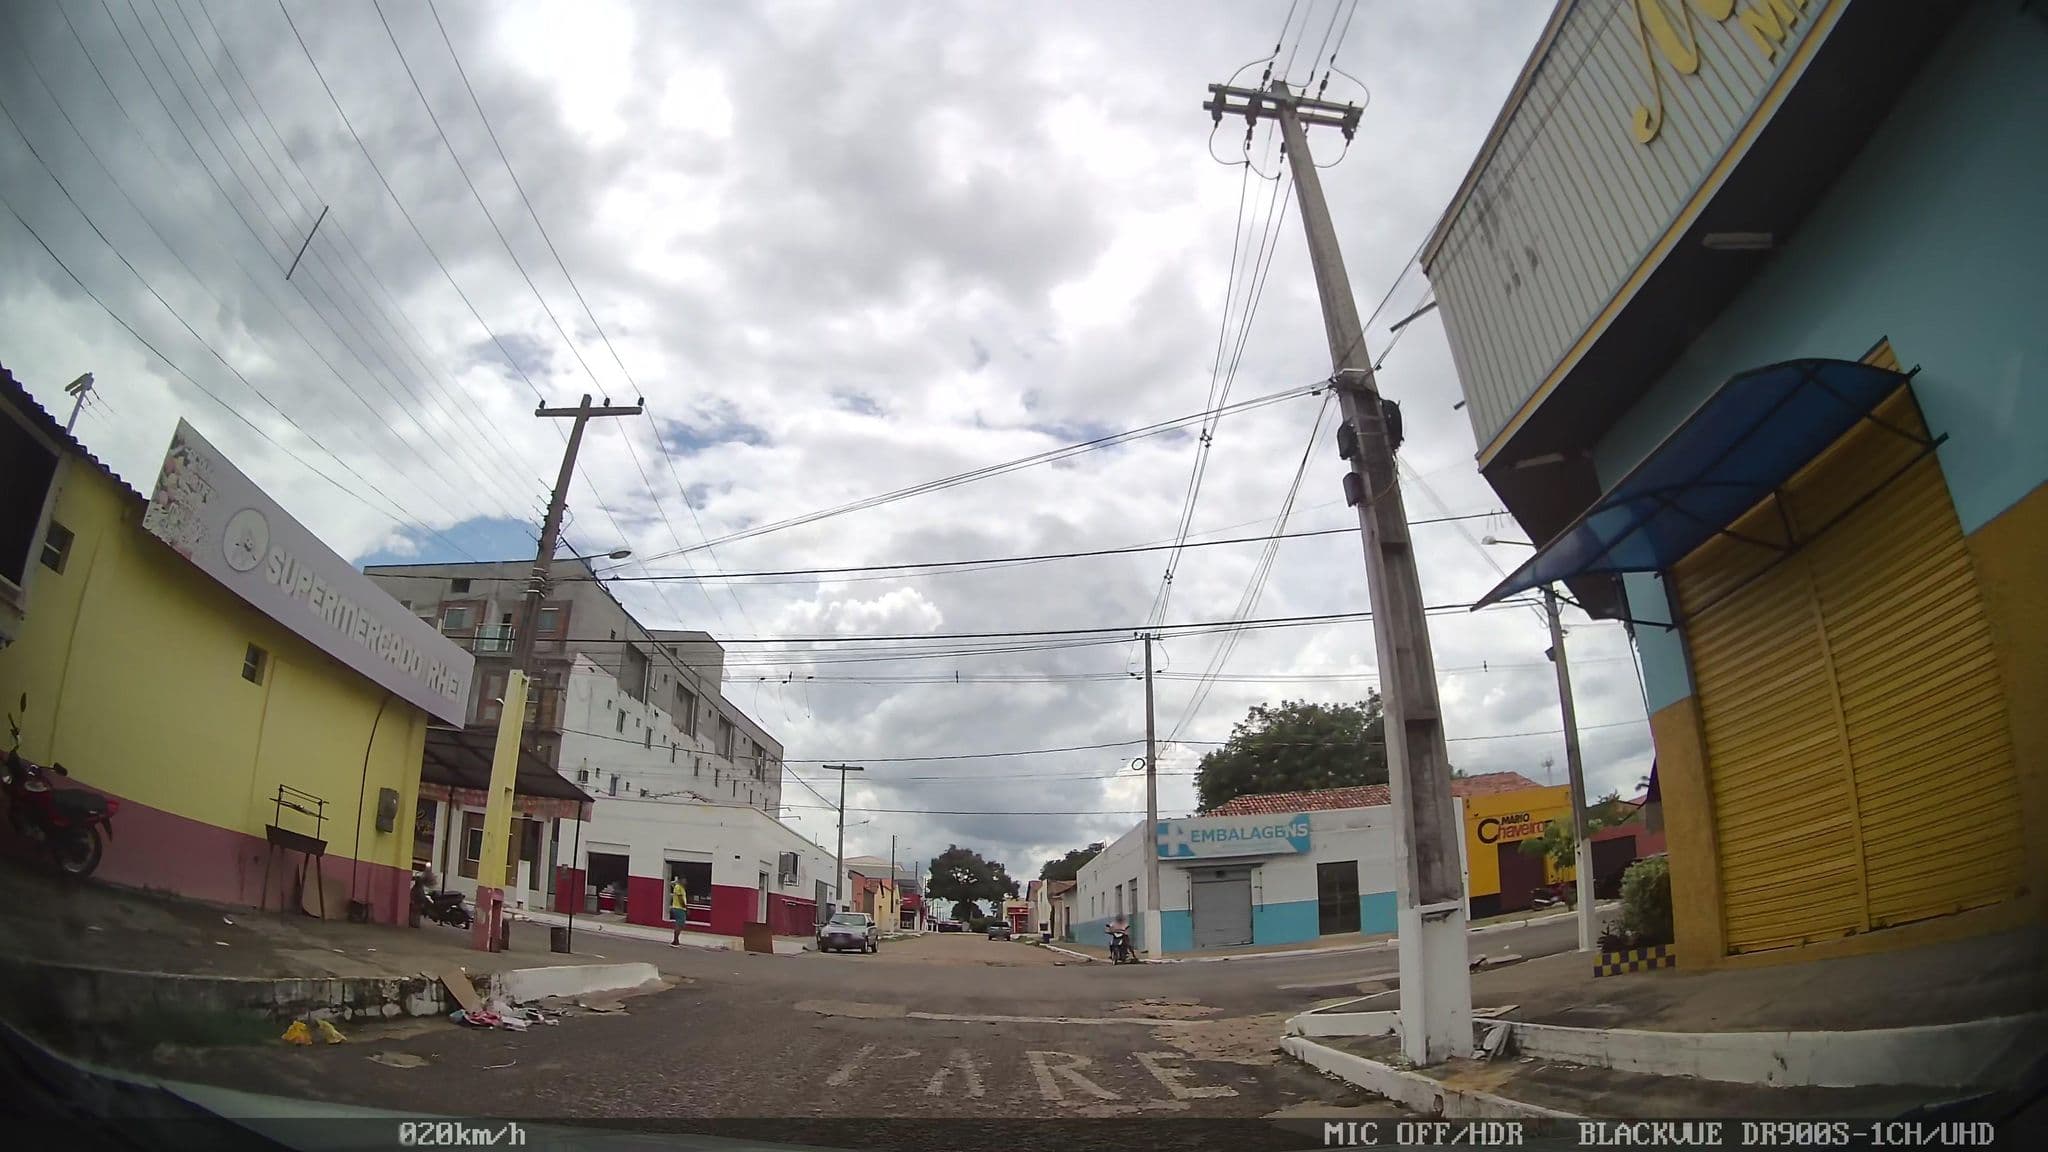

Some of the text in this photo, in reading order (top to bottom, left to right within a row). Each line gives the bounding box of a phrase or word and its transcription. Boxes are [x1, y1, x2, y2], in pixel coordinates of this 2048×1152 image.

[265, 544, 423, 677] SUPERMERCADO
[1191, 823, 1310, 843] EMBALAGENS
[1500, 813, 1531, 826] MARIO
[826, 1043, 1239, 1100] PARE
